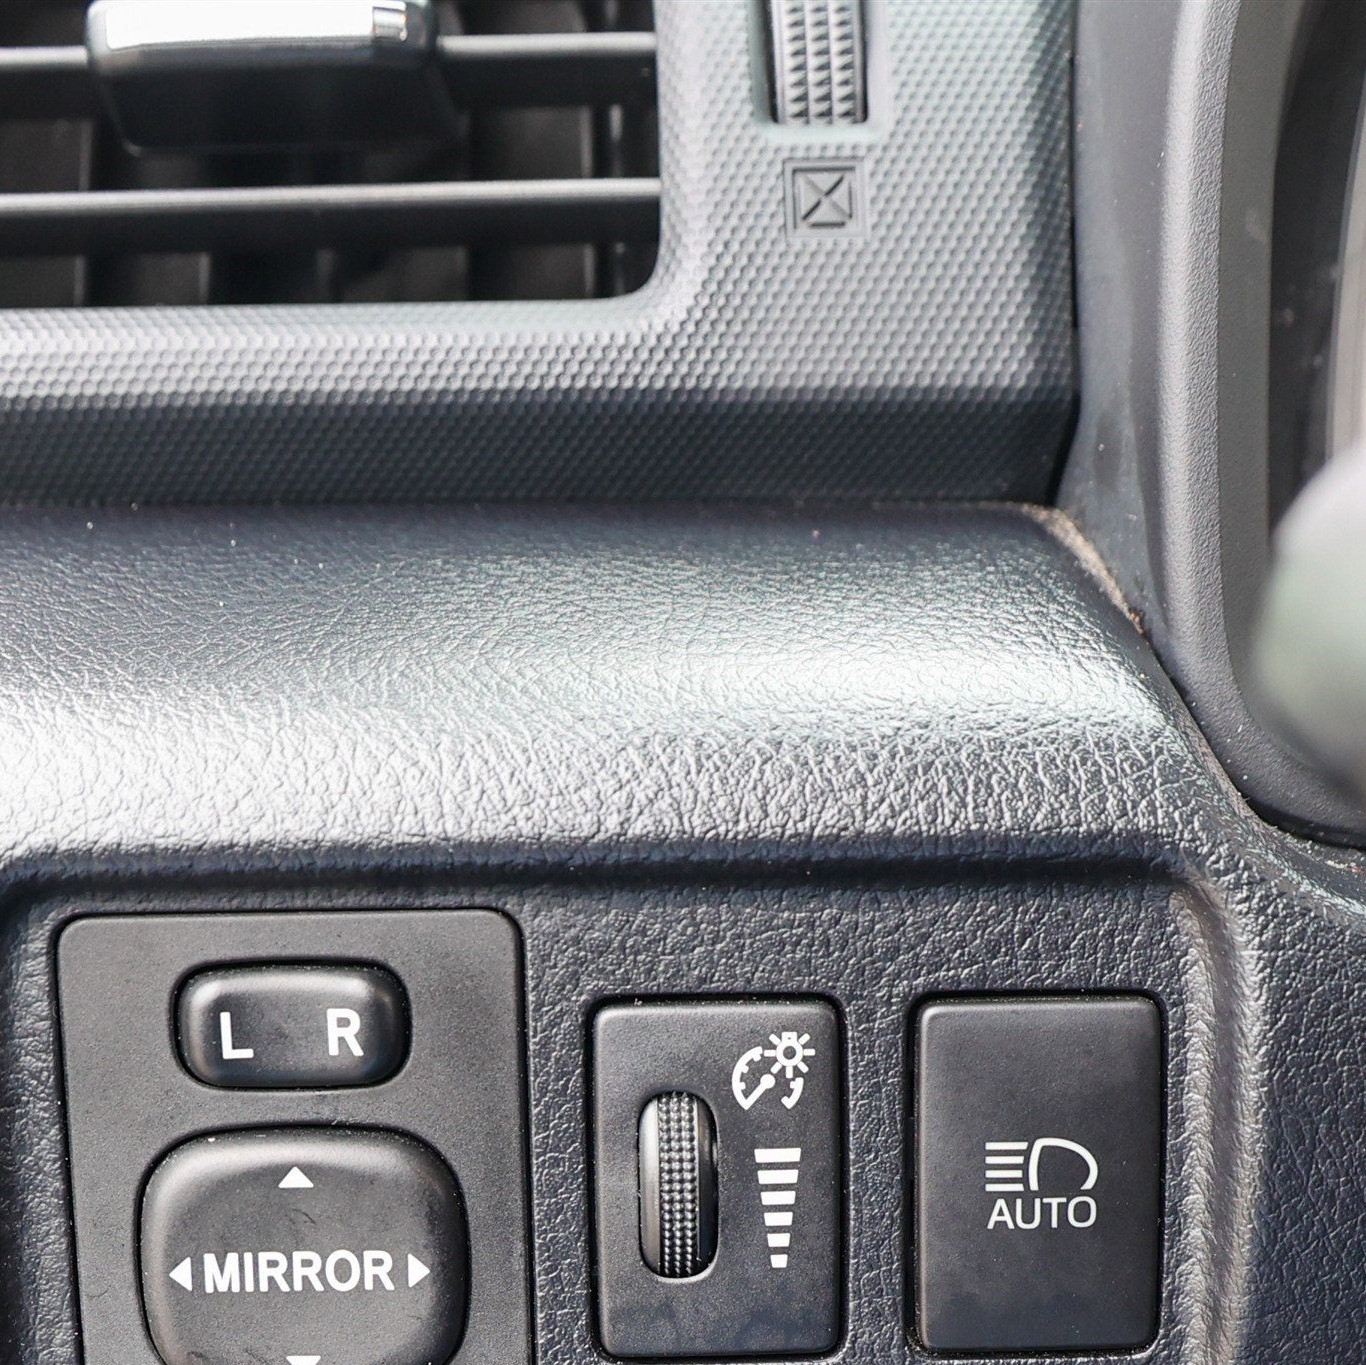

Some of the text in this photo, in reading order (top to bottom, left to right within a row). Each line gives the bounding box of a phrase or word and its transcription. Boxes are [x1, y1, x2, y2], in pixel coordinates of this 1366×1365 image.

[219, 1008, 364, 1060] L R
[987, 1196, 1097, 1230] AUTO
[202, 1249, 396, 1294] MIRROR
